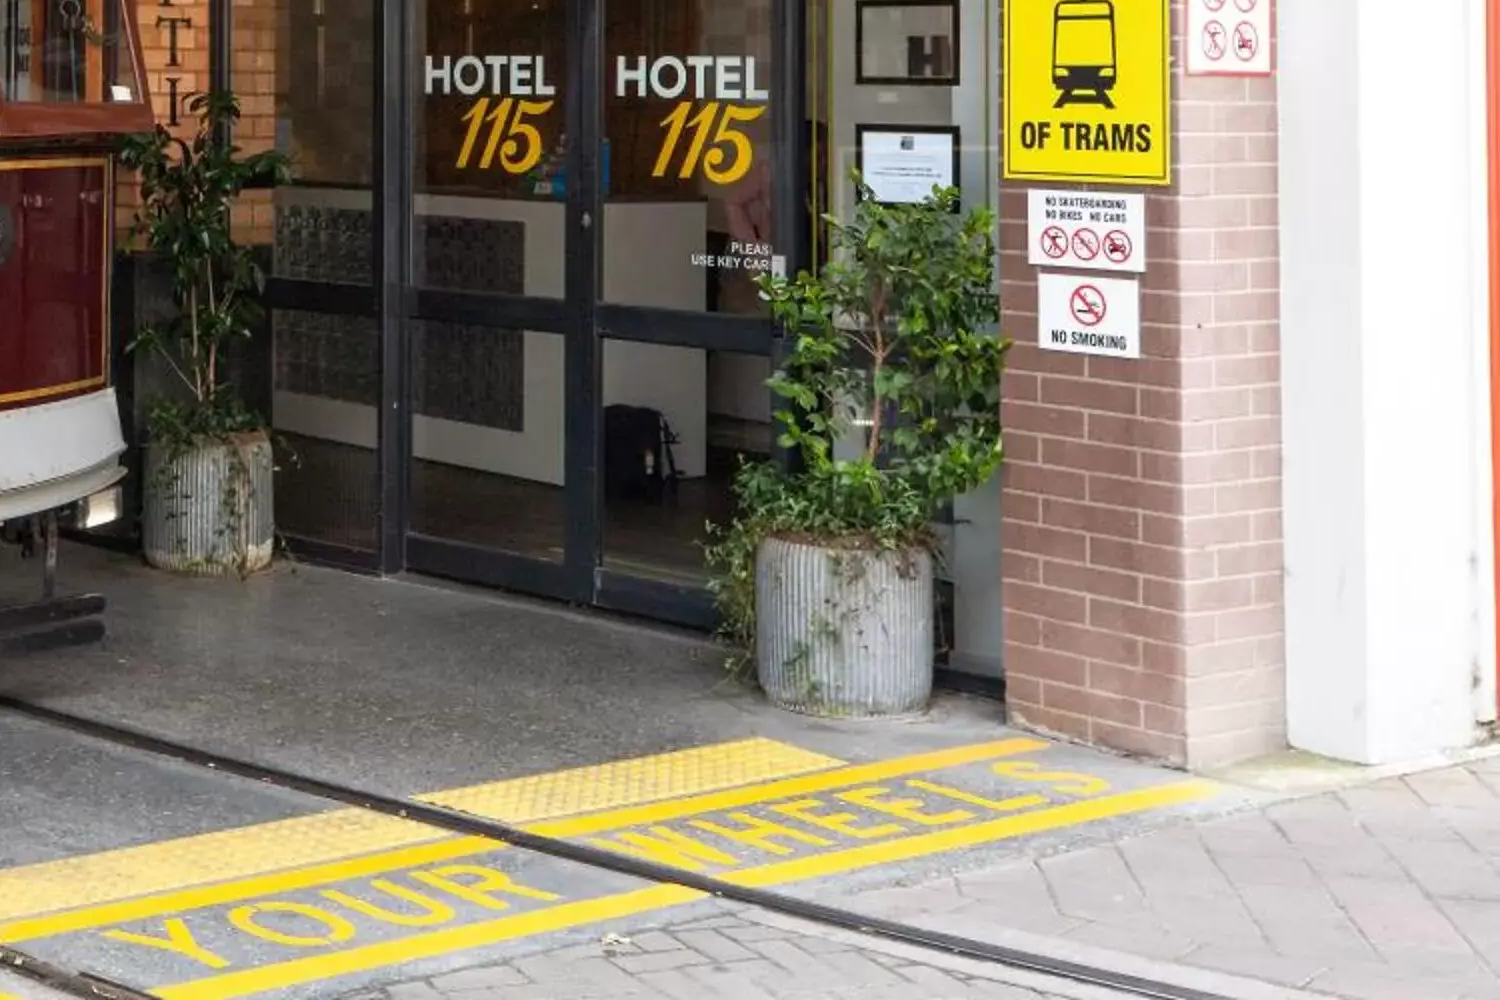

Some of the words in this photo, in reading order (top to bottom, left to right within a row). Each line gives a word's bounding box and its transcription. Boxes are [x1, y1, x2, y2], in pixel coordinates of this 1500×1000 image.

[424, 55, 556, 96] HOTEL
[616, 55, 769, 100] HOTEL
[456, 97, 554, 174] 115
[651, 101, 767, 184] 115
[1021, 121, 1051, 150] OF
[1060, 122, 1152, 152] TRAMS
[1046, 197, 1057, 207] NO
[1059, 197, 1127, 210] SKATEBOARDING
[1046, 210, 1057, 219] NO
[1059, 210, 1083, 221] BIKES
[1090, 211, 1101, 222] NO
[1104, 212, 1127, 224] CARS
[691, 254, 715, 267] USE
[717, 255, 741, 269] KEY
[743, 257, 773, 271] CAR
[1051, 330, 1067, 345] NO
[1071, 331, 1128, 350] SMOKING
[101, 865, 564, 968] YOUR
[592, 761, 1110, 870] WHEELS
